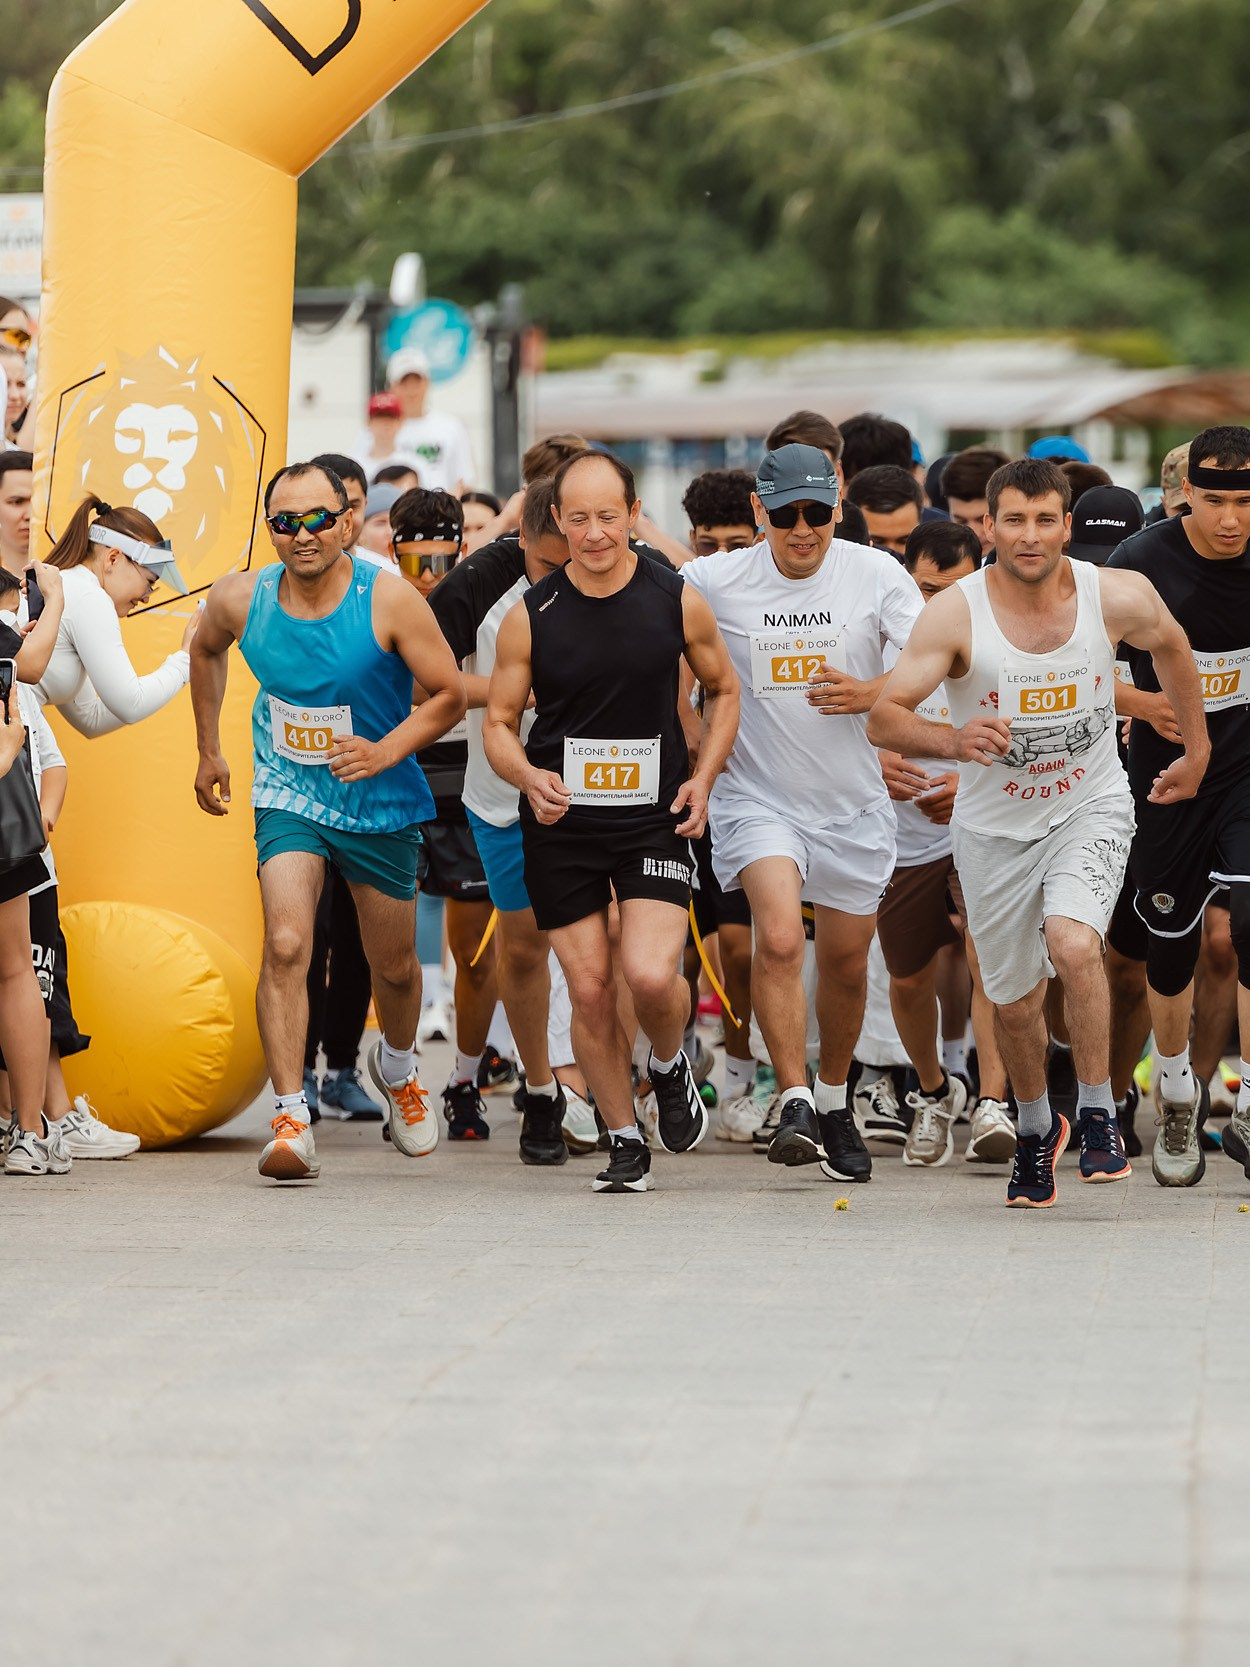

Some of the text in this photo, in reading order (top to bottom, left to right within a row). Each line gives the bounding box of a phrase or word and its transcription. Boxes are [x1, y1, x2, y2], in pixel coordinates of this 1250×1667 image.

[764, 611, 832, 627] NAIMAN
[758, 640, 837, 651] LEONE D'ORO
[777, 658, 821, 679] 412
[1007, 667, 1088, 683] LEONE D'ORO
[1026, 688, 1069, 711] 501
[274, 705, 343, 722] LEONE D'ORO
[1012, 712, 1071, 722] ЛАГОТВОРИТЕЛЬНЫЙ
[288, 728, 328, 749] 410
[573, 747, 652, 756] LEONE D'ORO
[1028, 758, 1065, 774] AGAIN
[589, 766, 634, 787] 417
[1003, 767, 1085, 800] ROUND
[573, 791, 634, 799] БЛАГОТВОРИТЕЛЬНЫЙ
[643, 857, 690, 885] ULTIMATE
